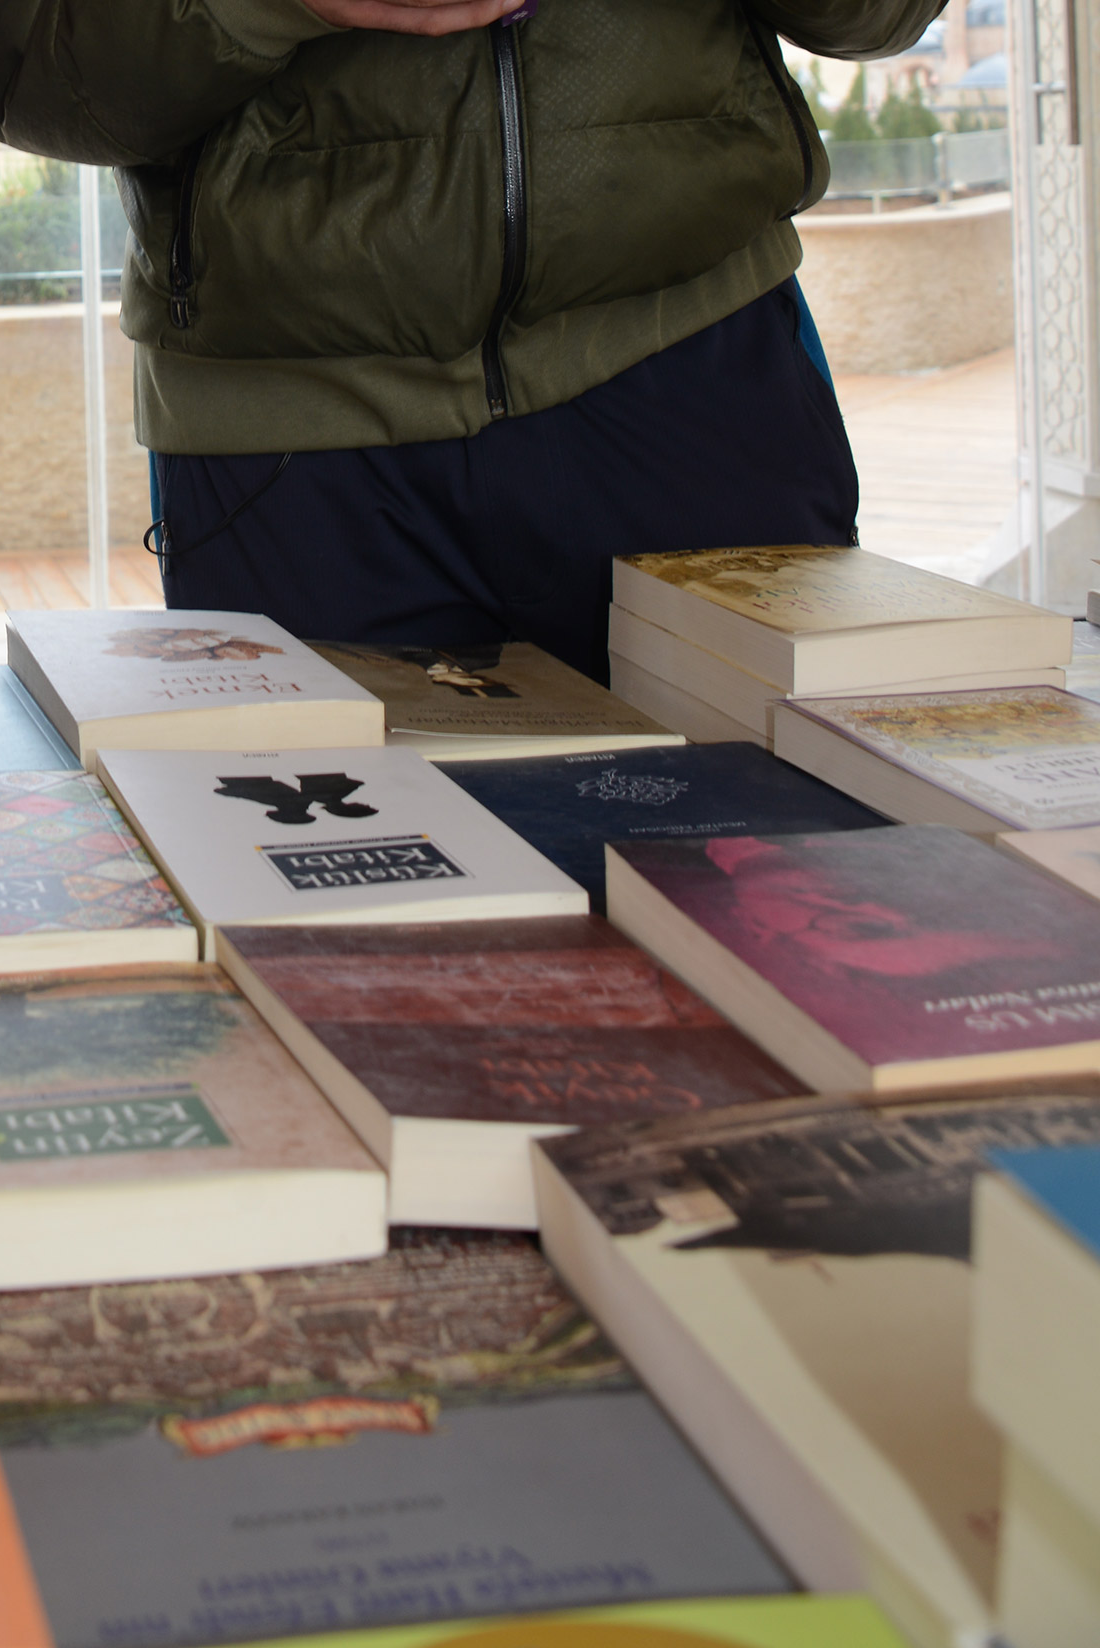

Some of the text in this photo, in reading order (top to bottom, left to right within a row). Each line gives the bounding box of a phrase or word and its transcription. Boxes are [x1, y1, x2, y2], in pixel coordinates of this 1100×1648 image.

[149, 682, 303, 700] Ekmek
[287, 846, 430, 869] Kitabı
[290, 861, 457, 889] Küslük
[480, 1057, 658, 1083] Kitabı
[5, 1101, 189, 1134] Kitabı
[13, 1123, 210, 1156] Zeytin
